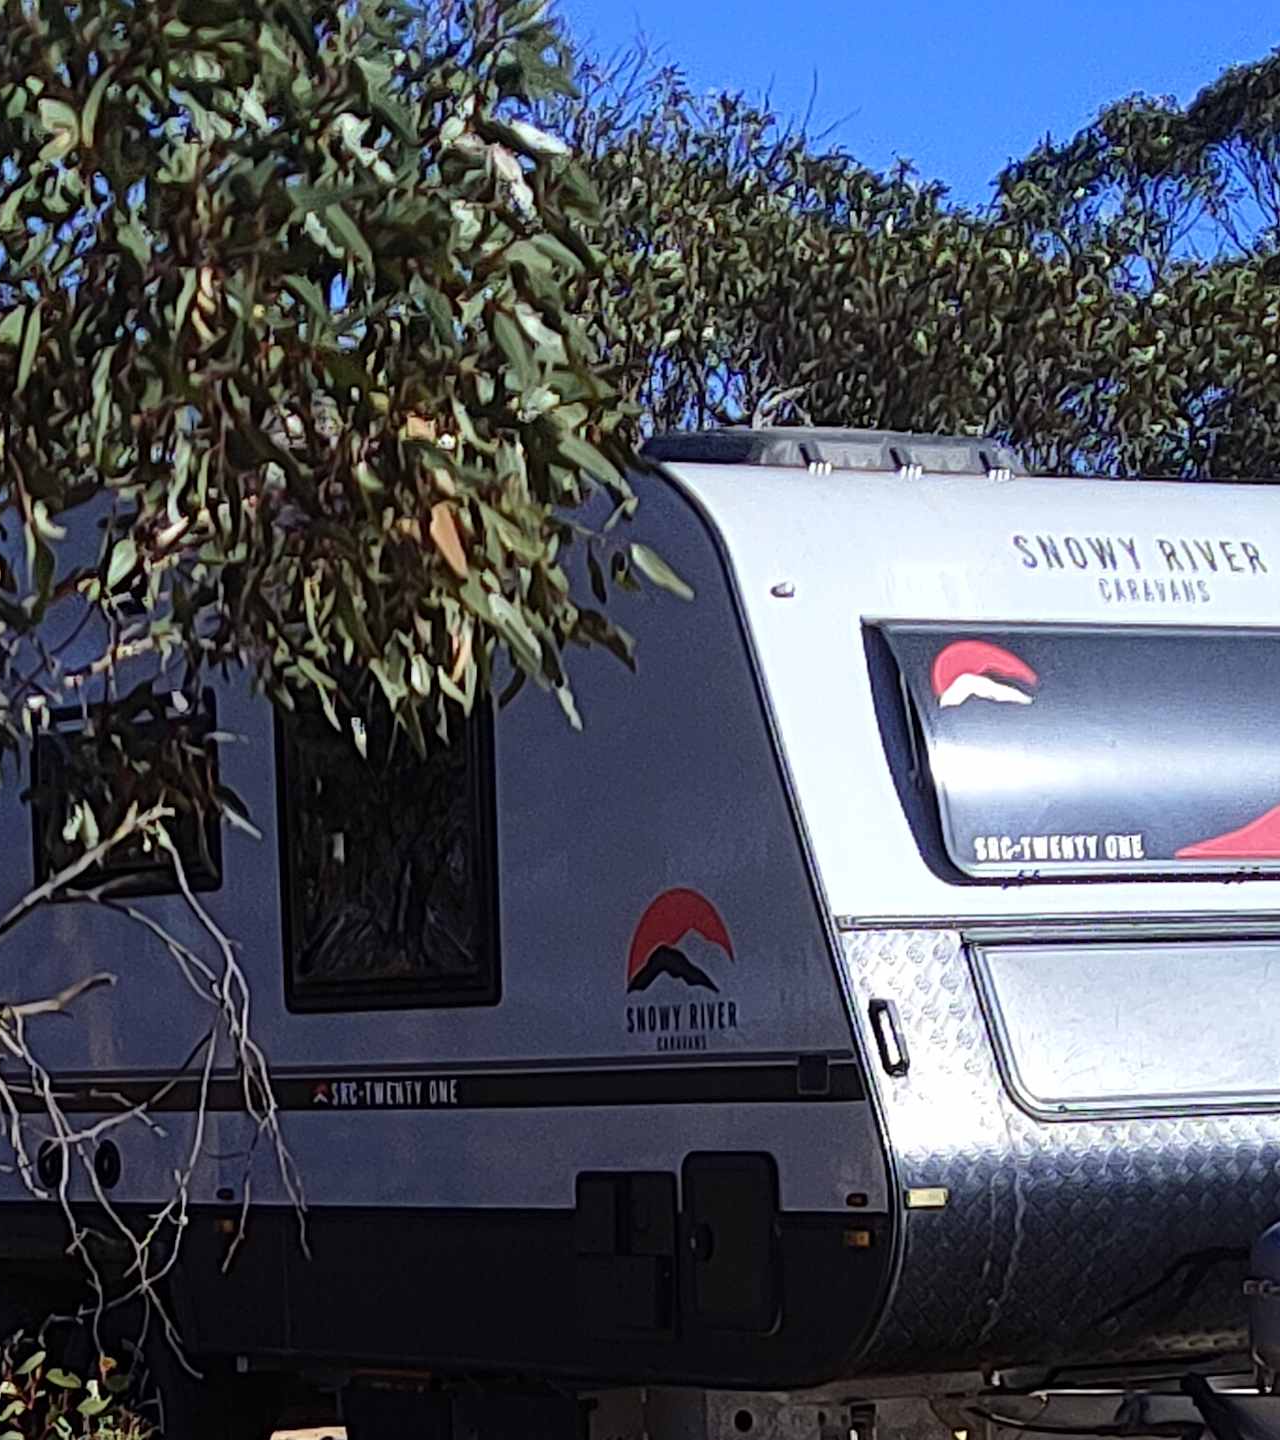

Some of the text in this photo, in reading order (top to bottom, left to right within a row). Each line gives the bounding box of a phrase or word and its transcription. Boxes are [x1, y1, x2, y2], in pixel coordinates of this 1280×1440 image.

[1013, 534, 1268, 574] SNOWY RIVER
[1098, 577, 1211, 604] CARAVANS
[1104, 833, 1145, 861] ONE
[626, 1001, 738, 1033] SNOWY RIVER
[429, 1079, 458, 1104] ONE
